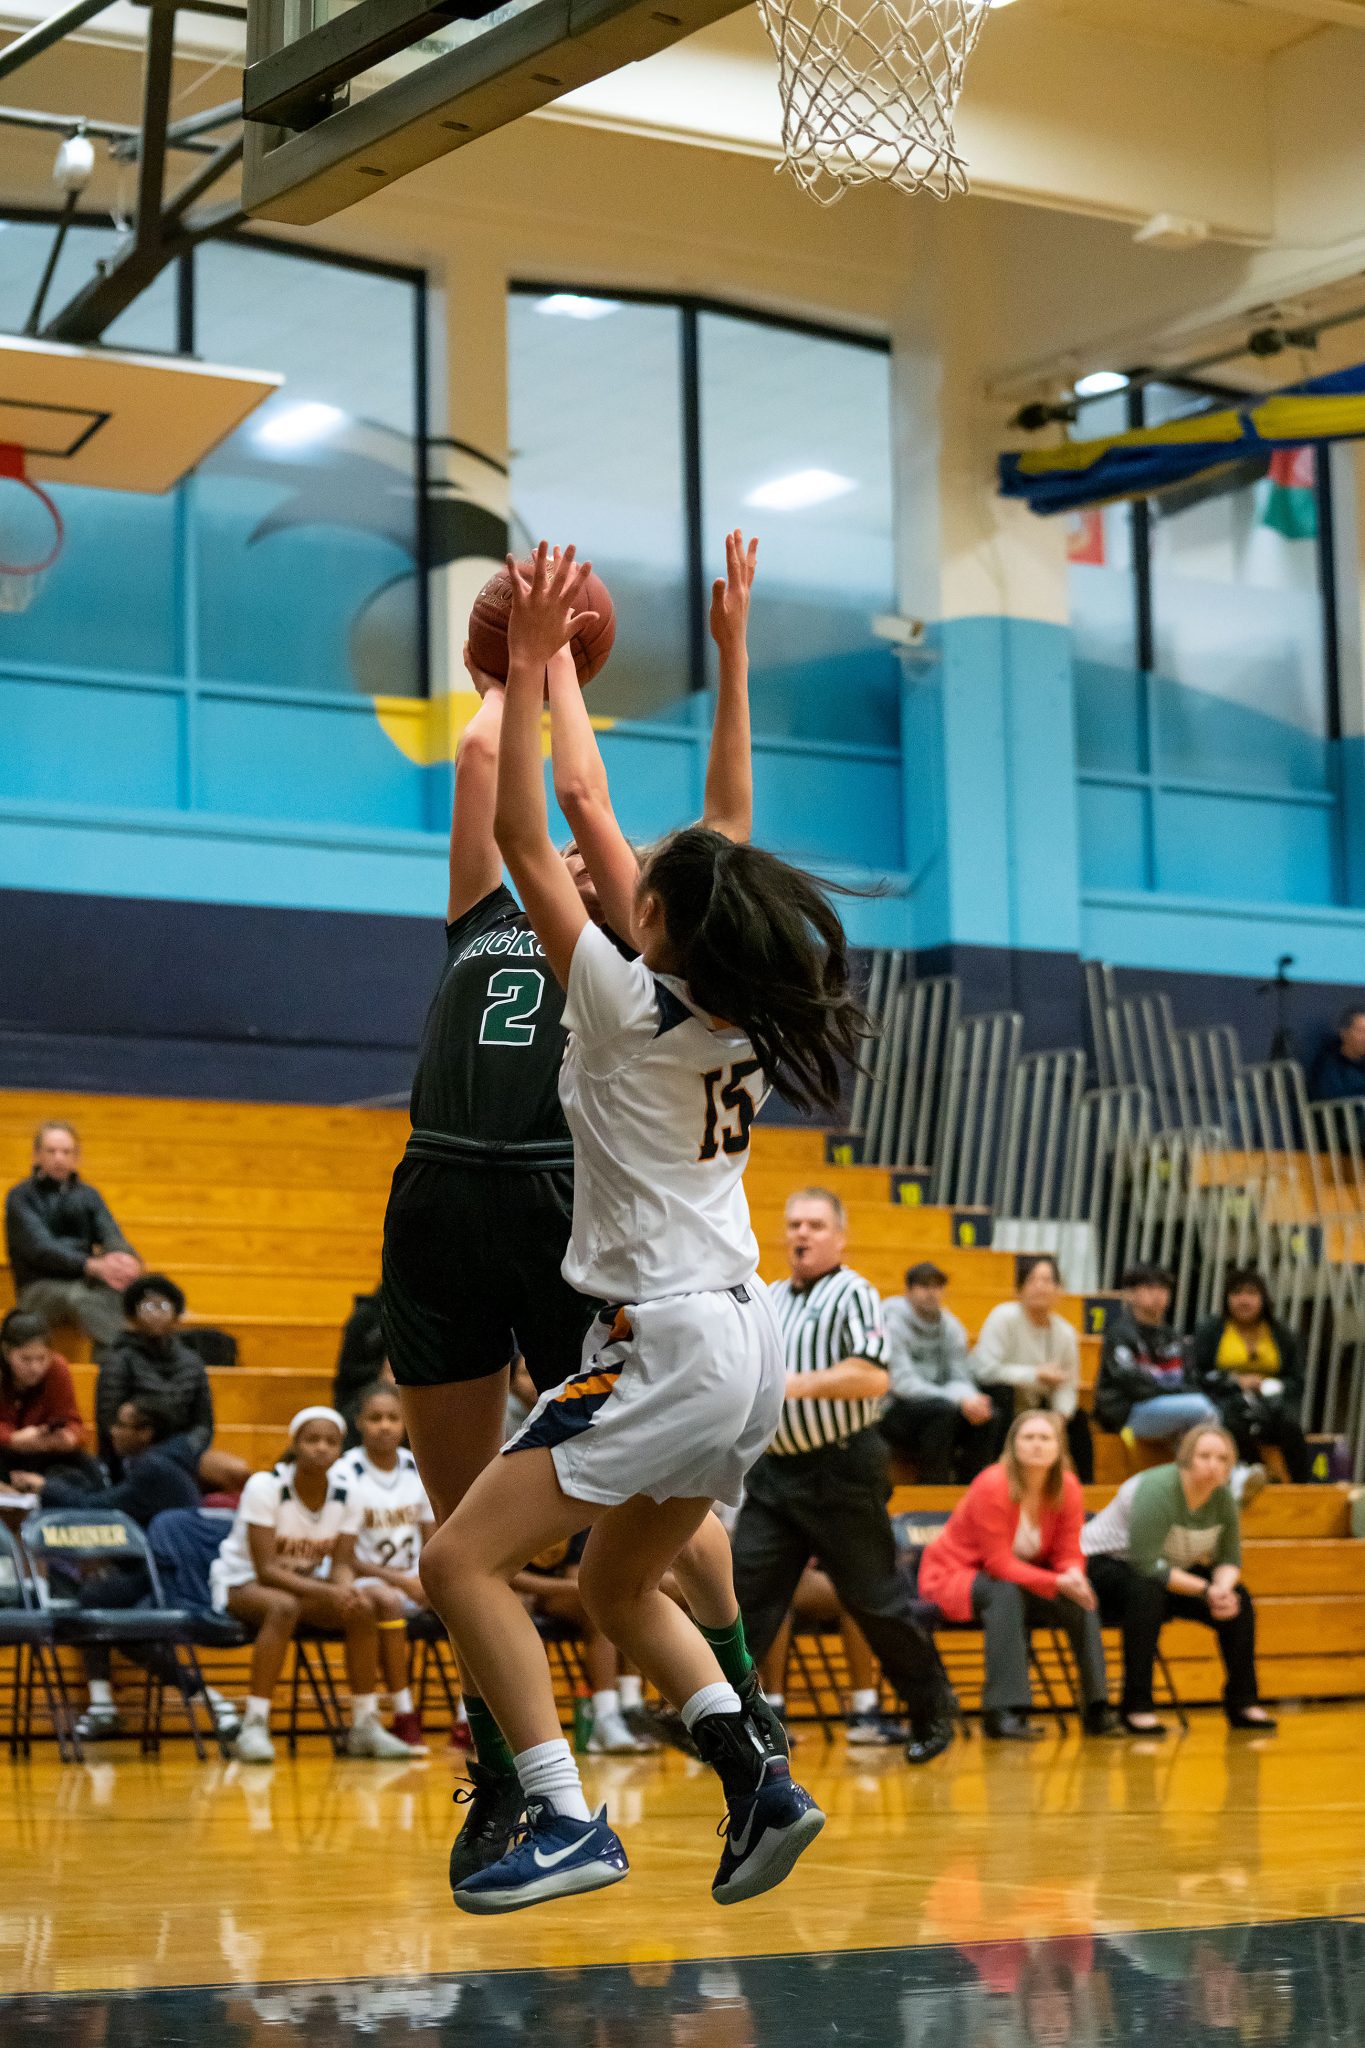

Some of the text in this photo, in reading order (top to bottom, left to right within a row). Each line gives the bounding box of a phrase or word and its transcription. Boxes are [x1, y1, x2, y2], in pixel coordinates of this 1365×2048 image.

[478, 968, 546, 1046] 2
[697, 1056, 764, 1162] 15
[1090, 1307, 1106, 1332] 7
